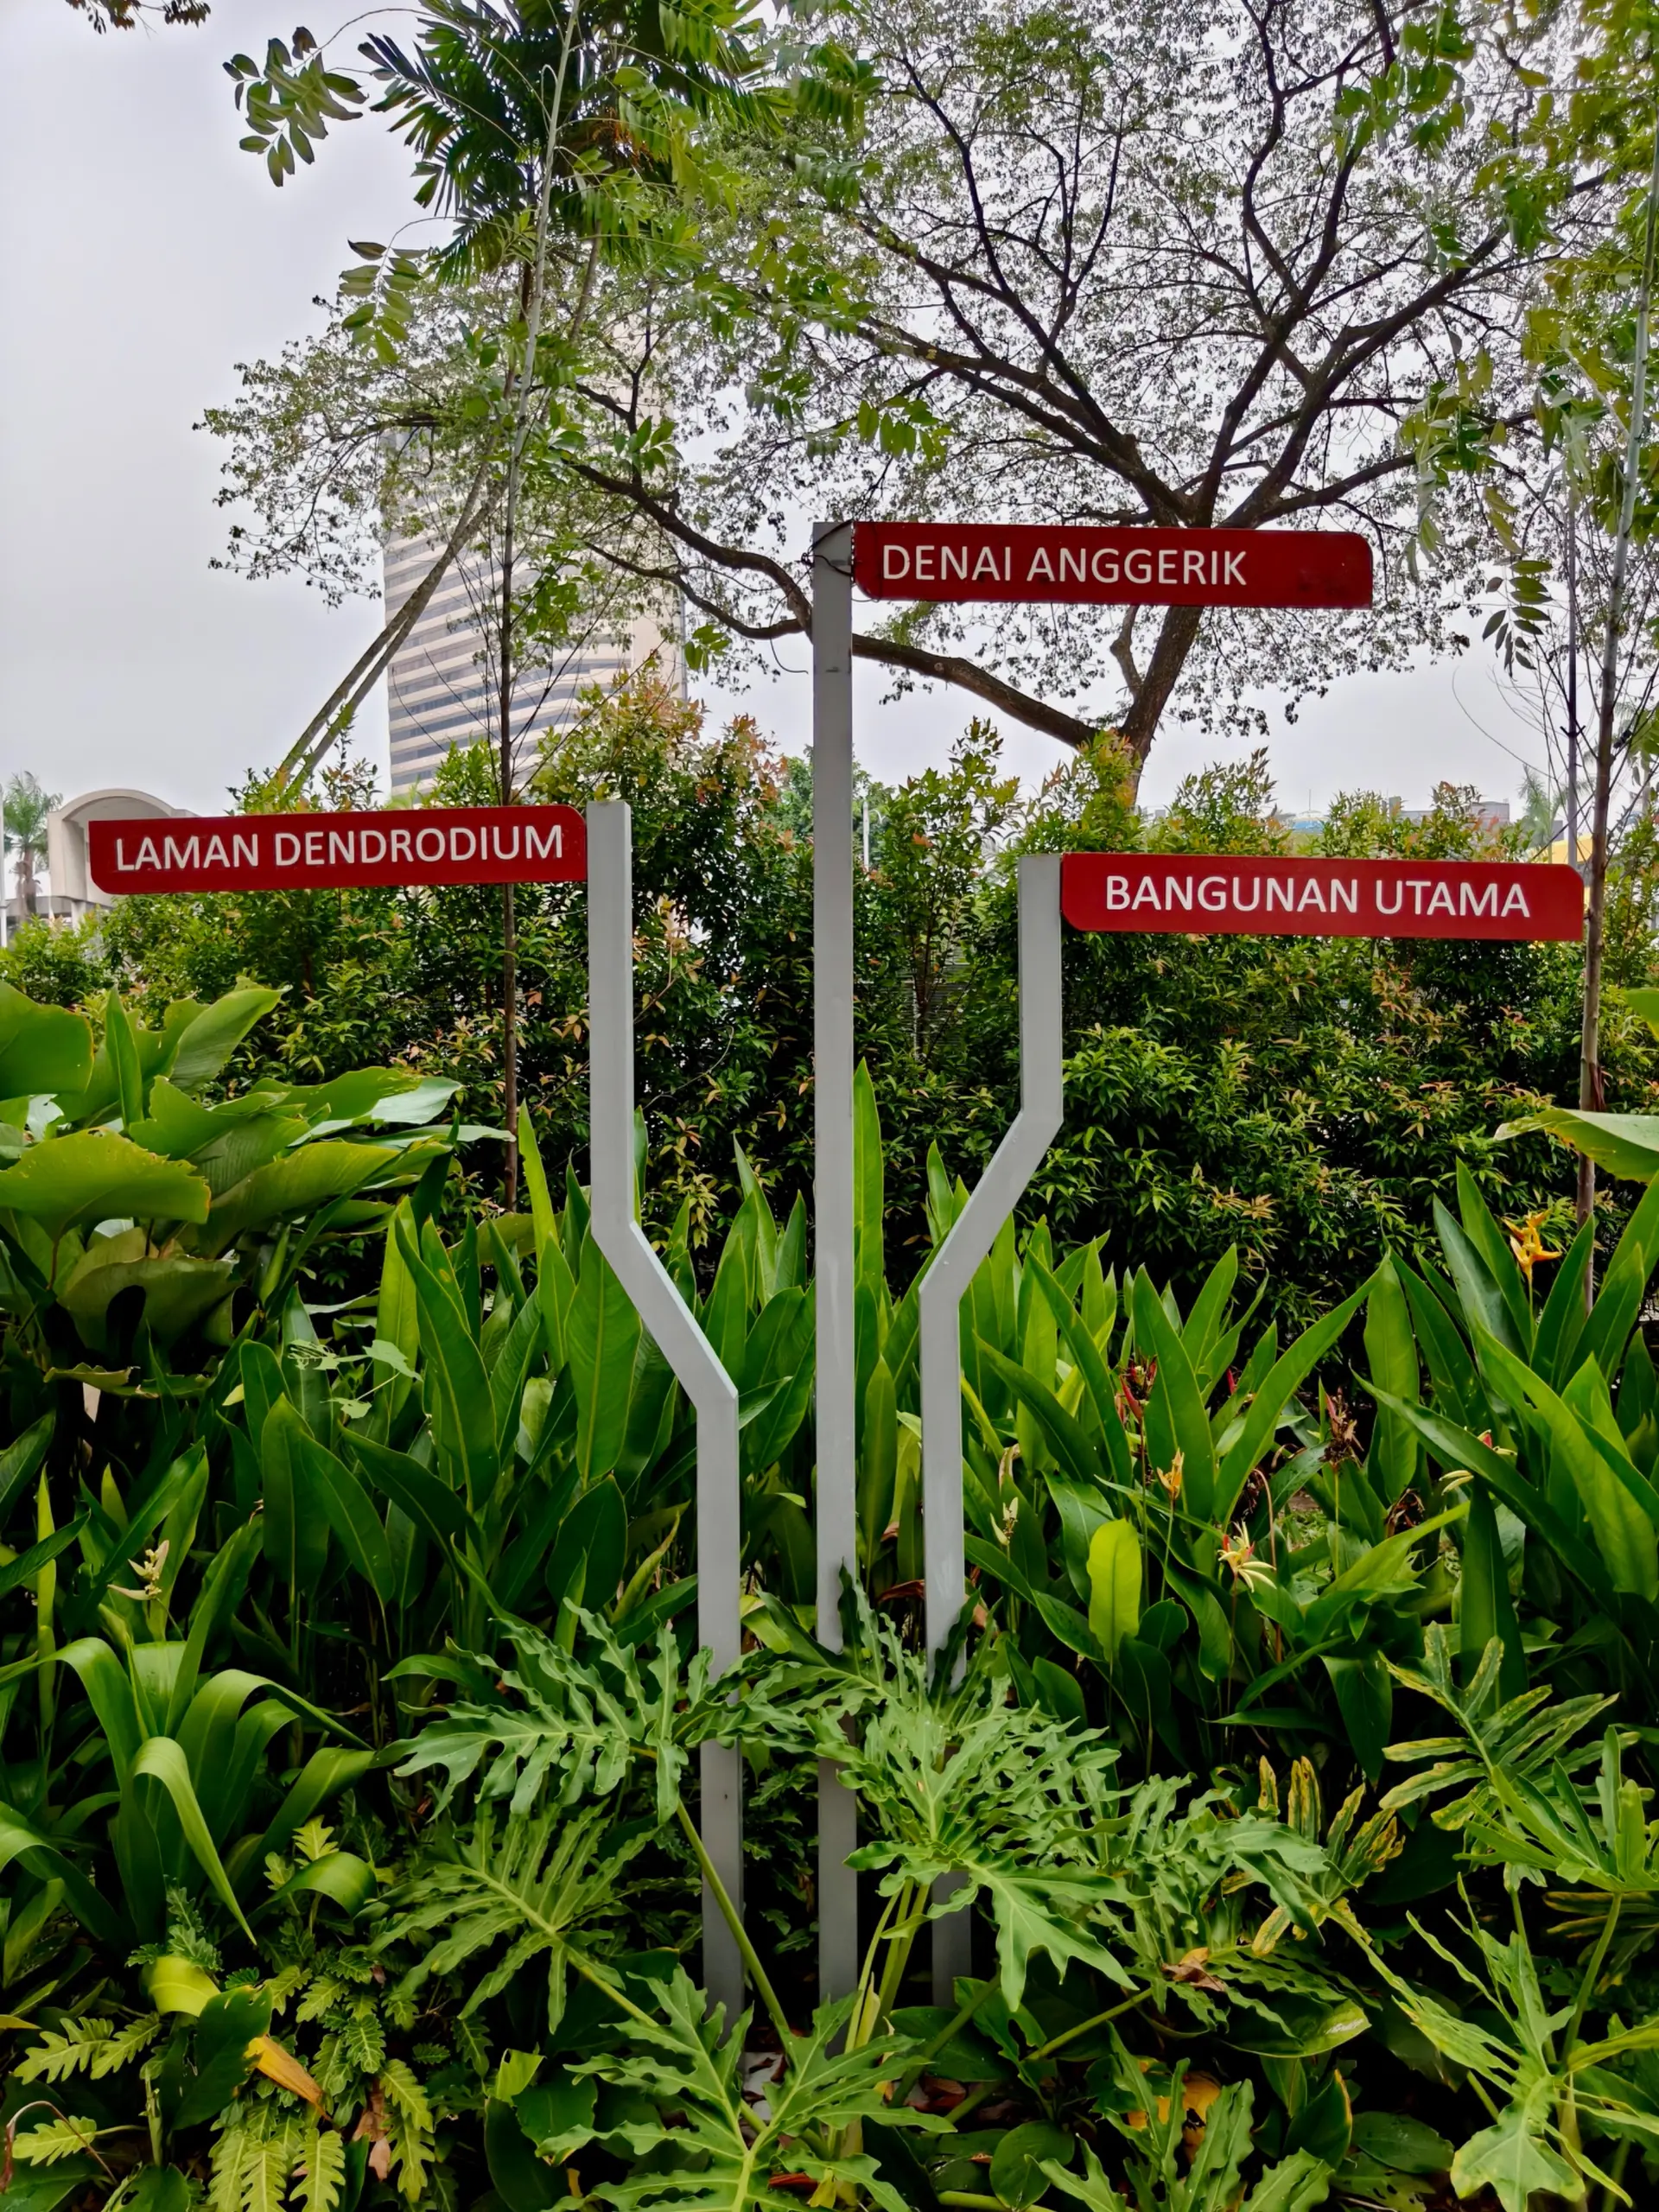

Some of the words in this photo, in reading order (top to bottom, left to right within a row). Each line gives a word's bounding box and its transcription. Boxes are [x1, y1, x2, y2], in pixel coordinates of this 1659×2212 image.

[881, 544, 1012, 582] DENAI
[1026, 547, 1248, 586] ANGGERIK
[115, 833, 259, 872] LAMAN
[274, 823, 564, 868] DENDRODIUM
[1105, 874, 1359, 914] BANGUNAN
[1375, 879, 1531, 918] UTAMA
